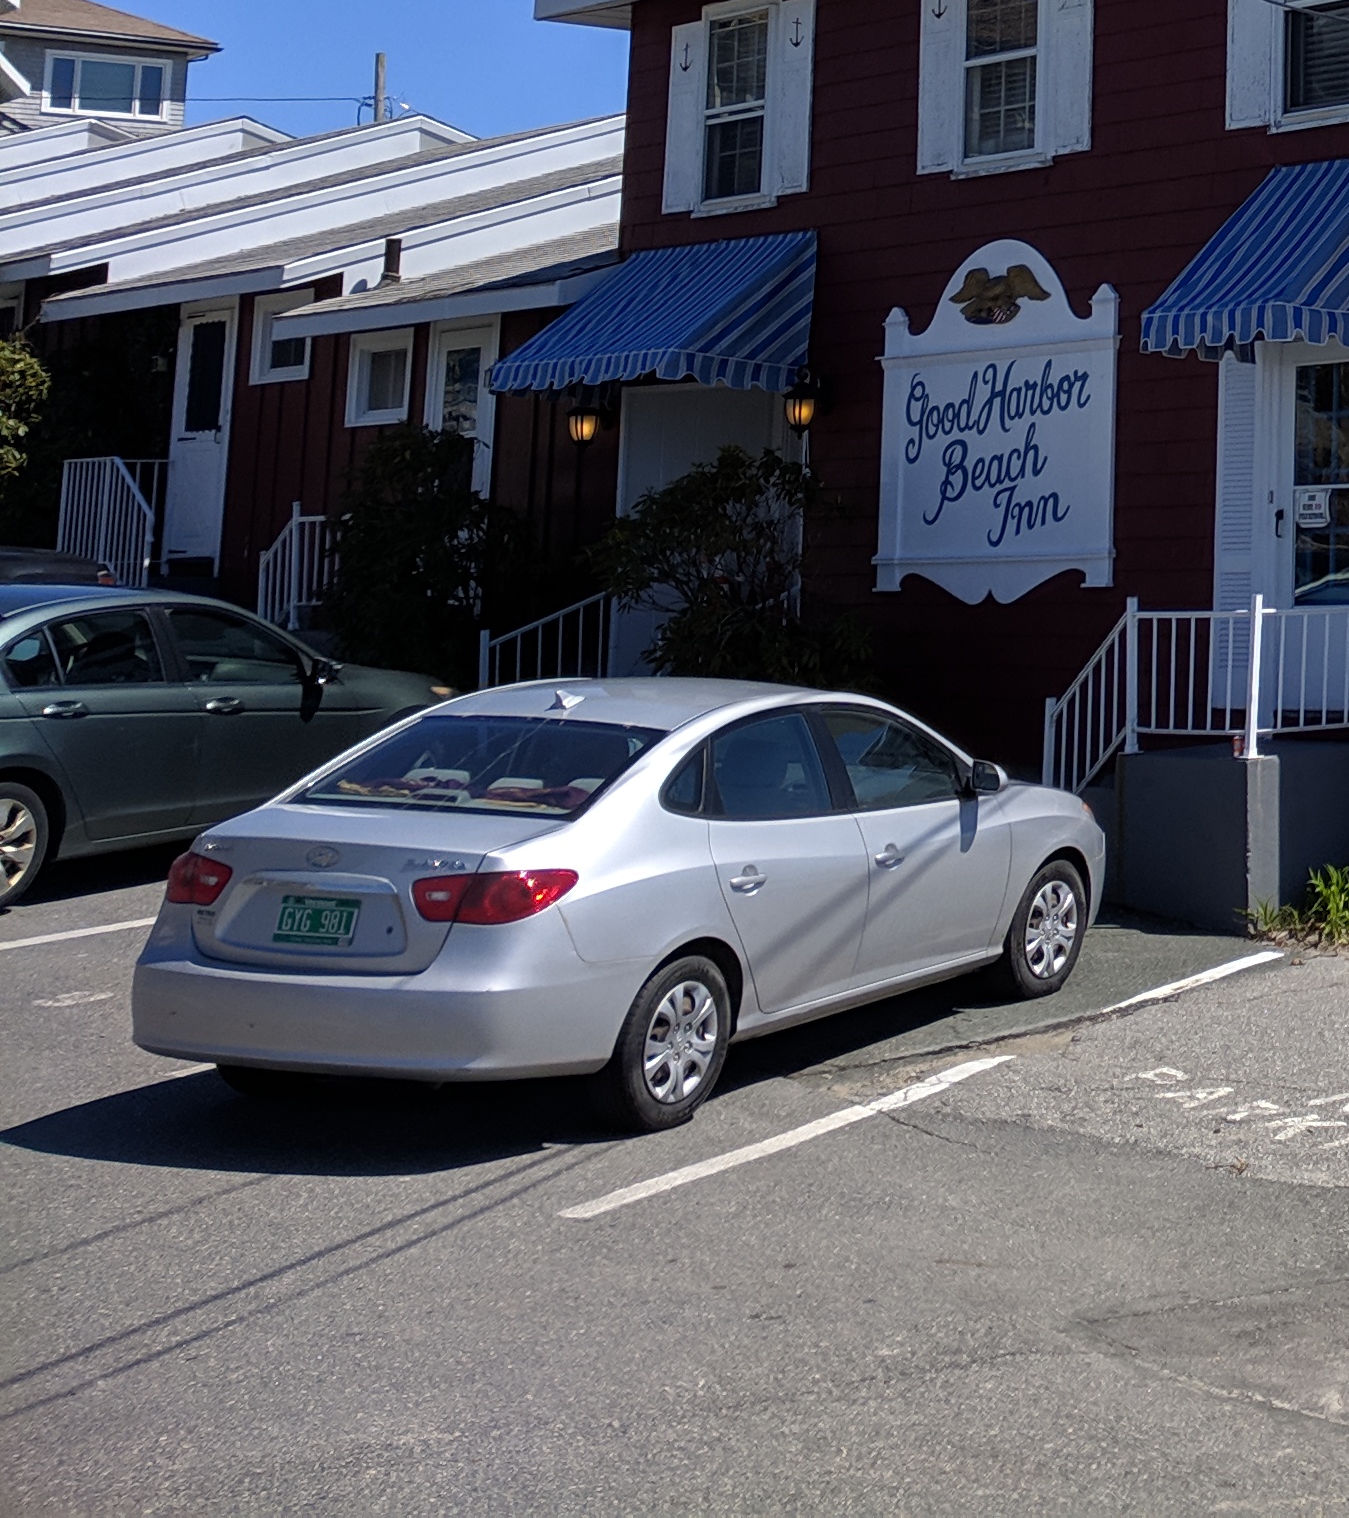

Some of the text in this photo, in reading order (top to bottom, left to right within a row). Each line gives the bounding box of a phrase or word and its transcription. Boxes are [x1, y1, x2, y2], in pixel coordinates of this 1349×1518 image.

[905, 359, 1091, 464] Good Harbor
[922, 423, 1048, 525] Beach
[987, 484, 1070, 548] Inn
[281, 907, 348, 934] GYG 981
